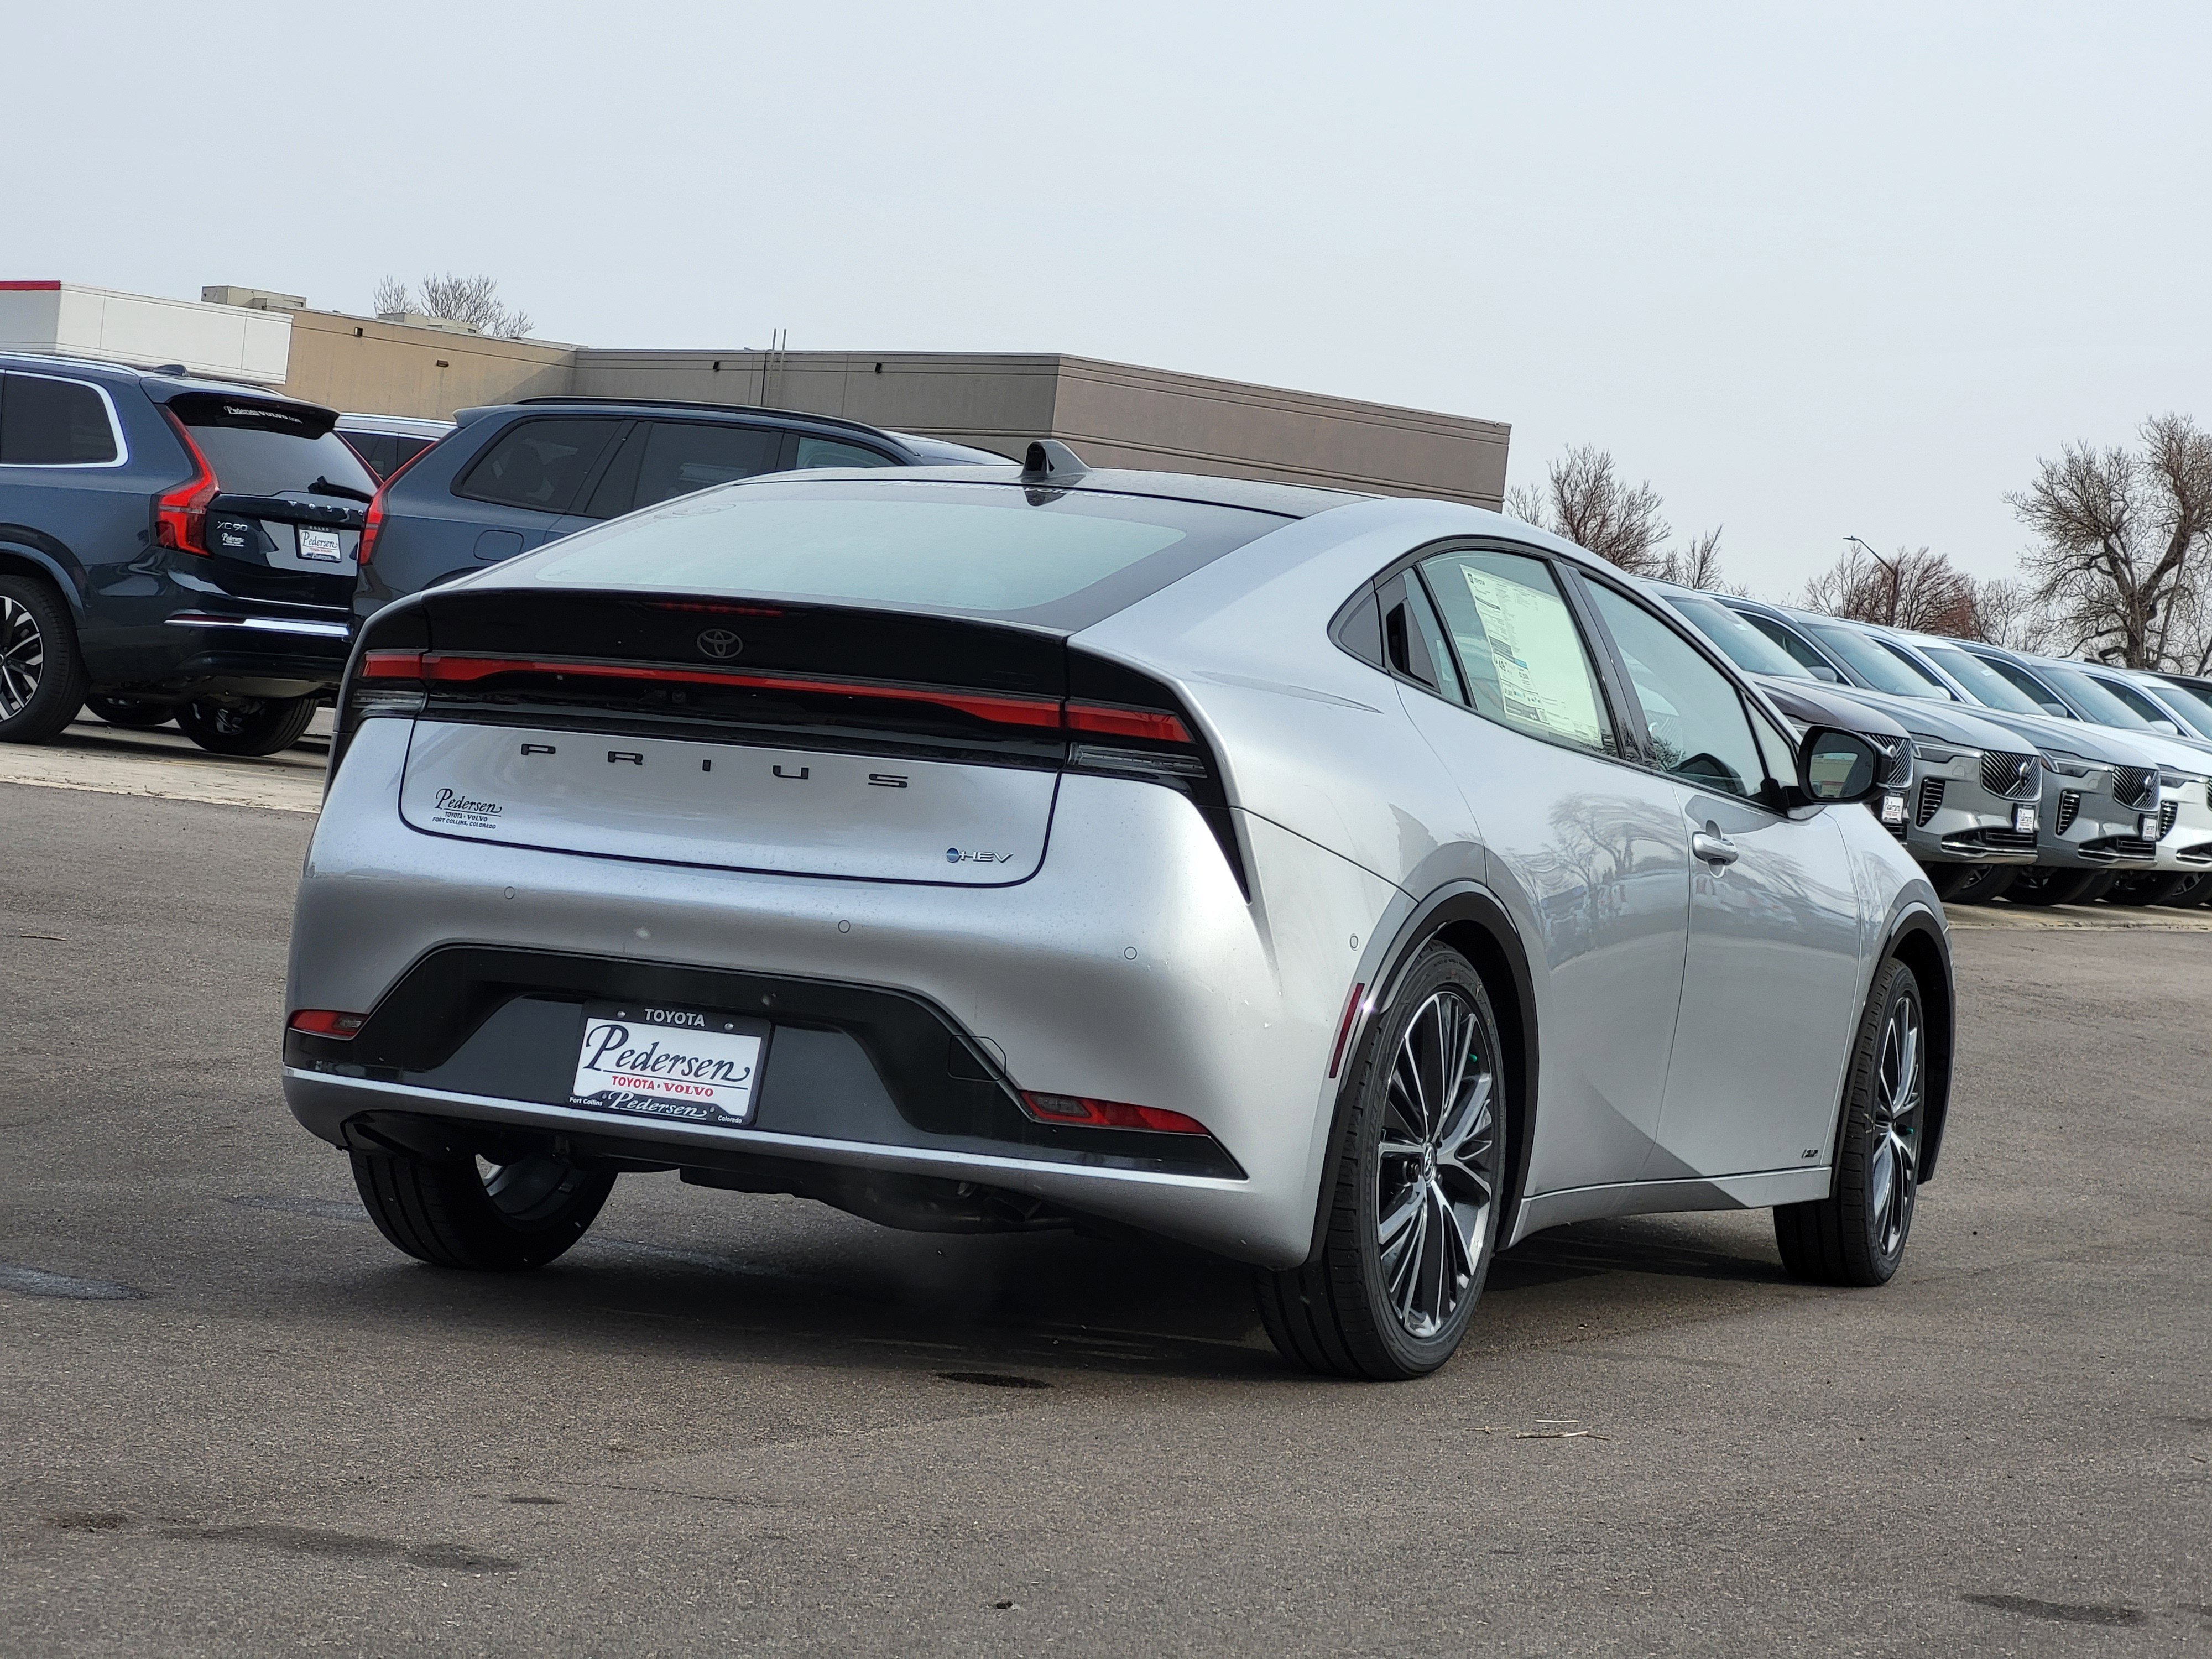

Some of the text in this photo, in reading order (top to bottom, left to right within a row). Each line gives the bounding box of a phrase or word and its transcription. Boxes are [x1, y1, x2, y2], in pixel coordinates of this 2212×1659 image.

[301, 531, 338, 548] Pedersen
[521, 743, 909, 788] PRIUS
[434, 788, 502, 813] Pedersen
[644, 1008, 705, 1027] TOYOTA
[582, 1024, 750, 1082] Pedersen
[612, 1076, 714, 1097] TOYOTA VOLVO
[583, 1098, 603, 1107] Collins
[608, 1091, 707, 1118] Pedersen
[718, 1115, 742, 1124] Colorado
